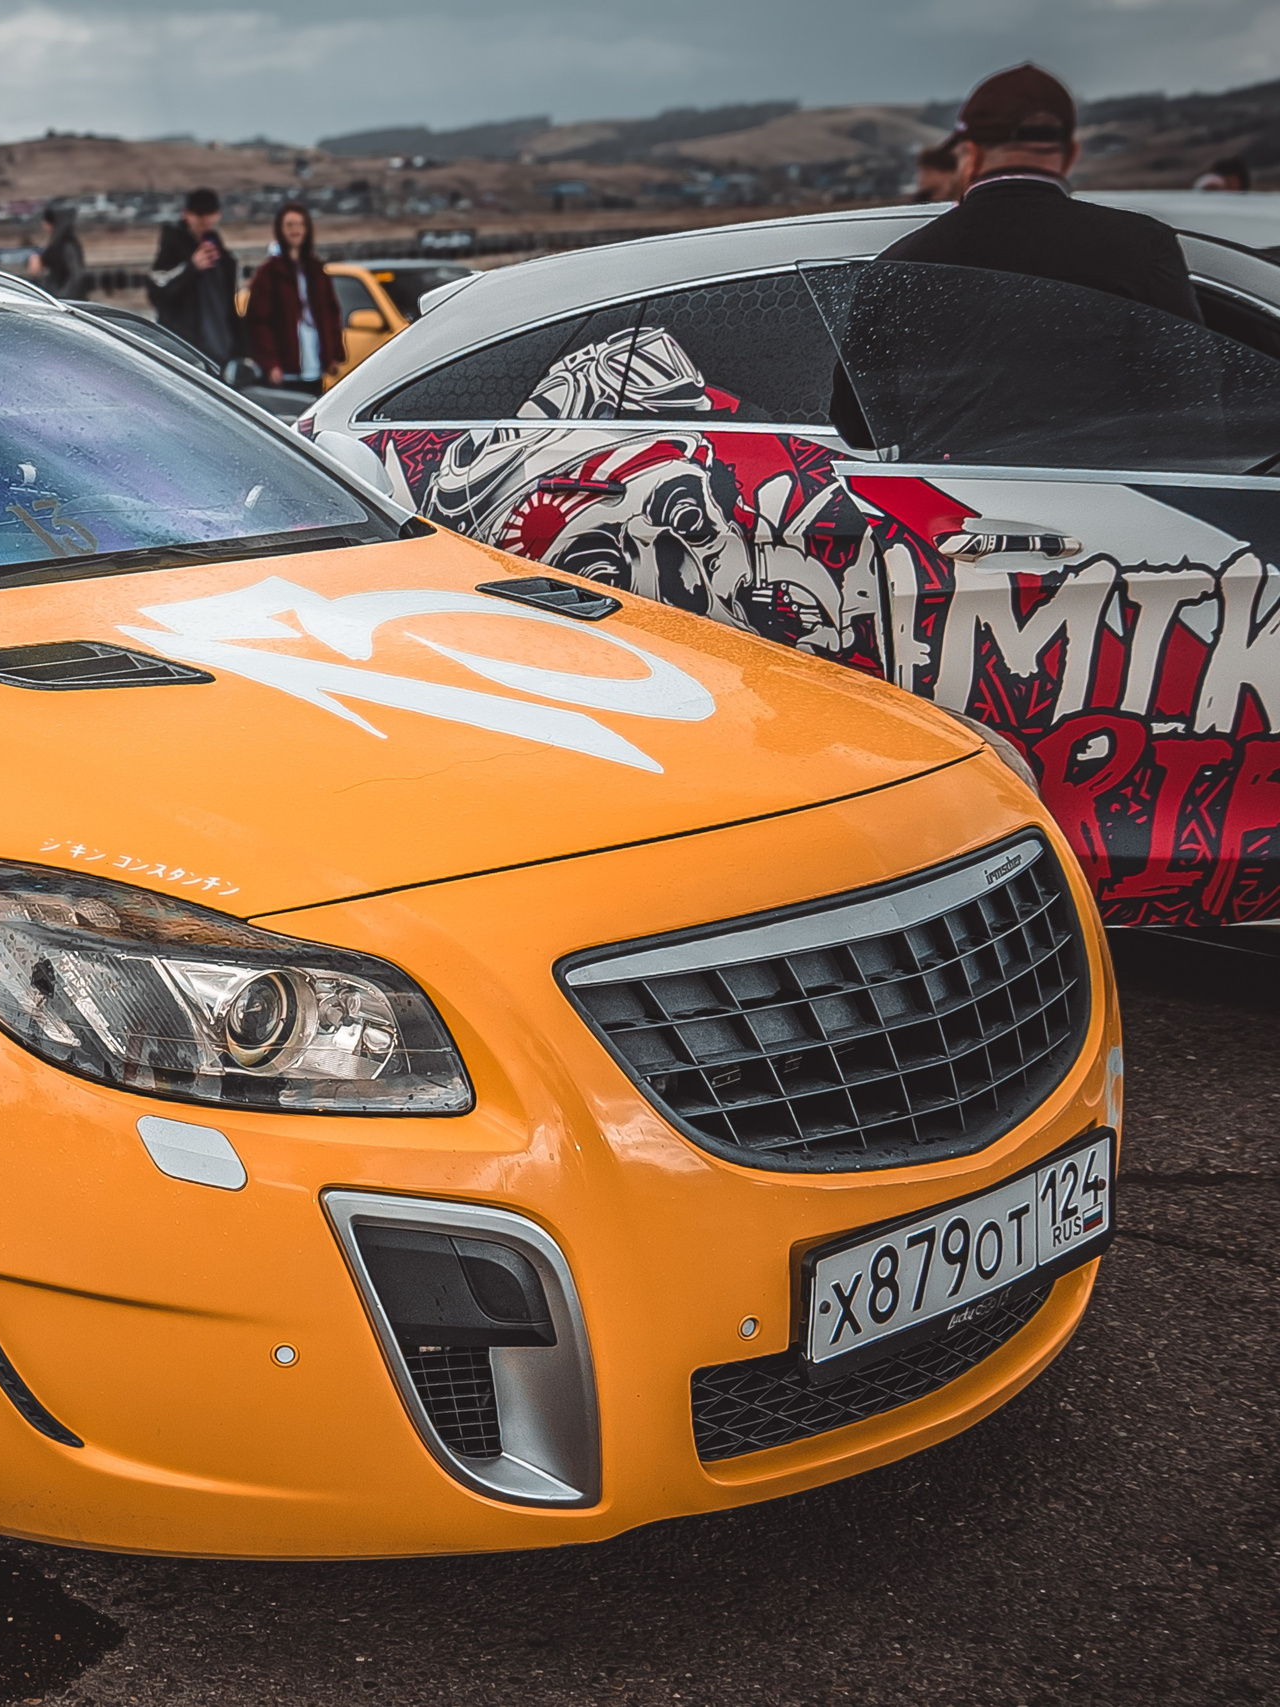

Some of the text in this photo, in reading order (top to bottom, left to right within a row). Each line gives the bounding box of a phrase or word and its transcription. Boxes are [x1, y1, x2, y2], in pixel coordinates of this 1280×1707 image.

[6, 499, 98, 557] 13
[1039, 1149, 1101, 1228] 124
[1052, 1216, 1082, 1248] RUS
